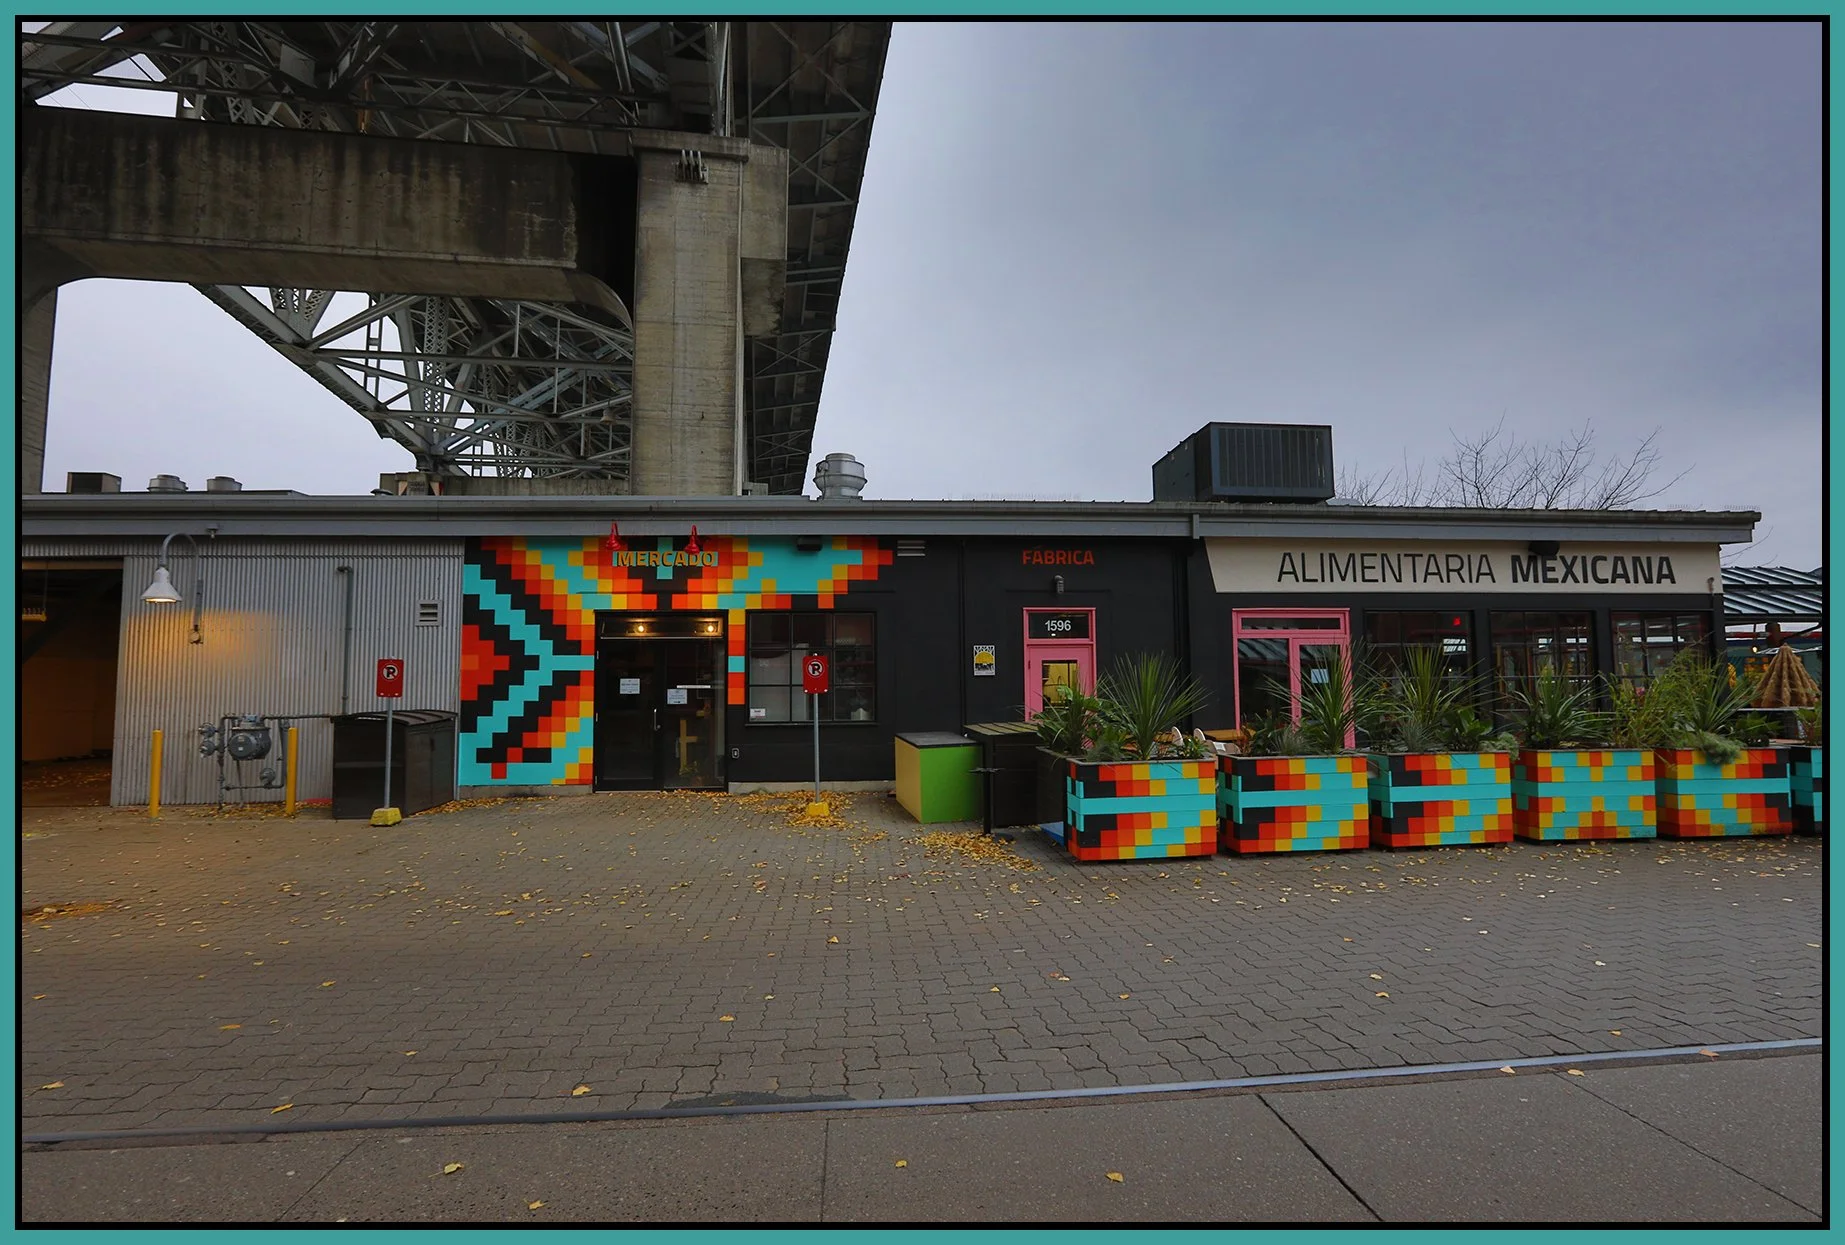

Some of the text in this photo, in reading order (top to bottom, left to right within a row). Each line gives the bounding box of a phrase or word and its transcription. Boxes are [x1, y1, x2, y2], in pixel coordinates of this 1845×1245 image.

[617, 551, 716, 566] MERCADO
[1277, 552, 1676, 584] ALIMENTARIA MEXICANA
[1045, 620, 1071, 632] 1596
